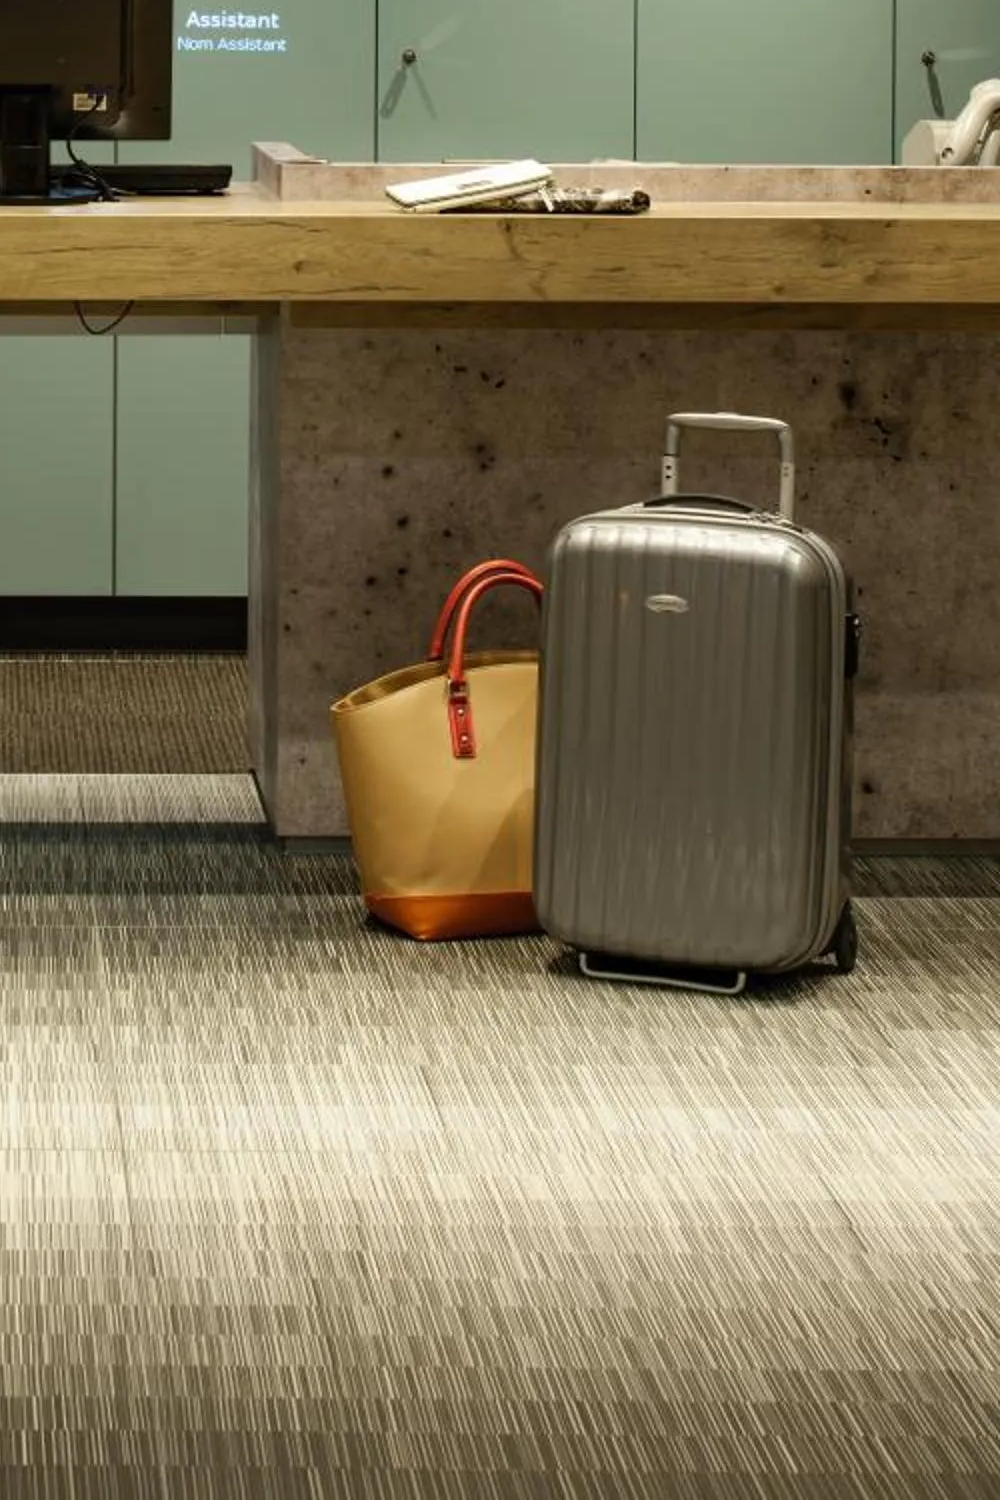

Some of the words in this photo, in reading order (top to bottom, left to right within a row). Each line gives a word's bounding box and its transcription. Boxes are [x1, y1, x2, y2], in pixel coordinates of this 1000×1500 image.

[185, 10, 280, 29] Assistant
[177, 36, 213, 51] Nom
[217, 38, 287, 52] Assistant
